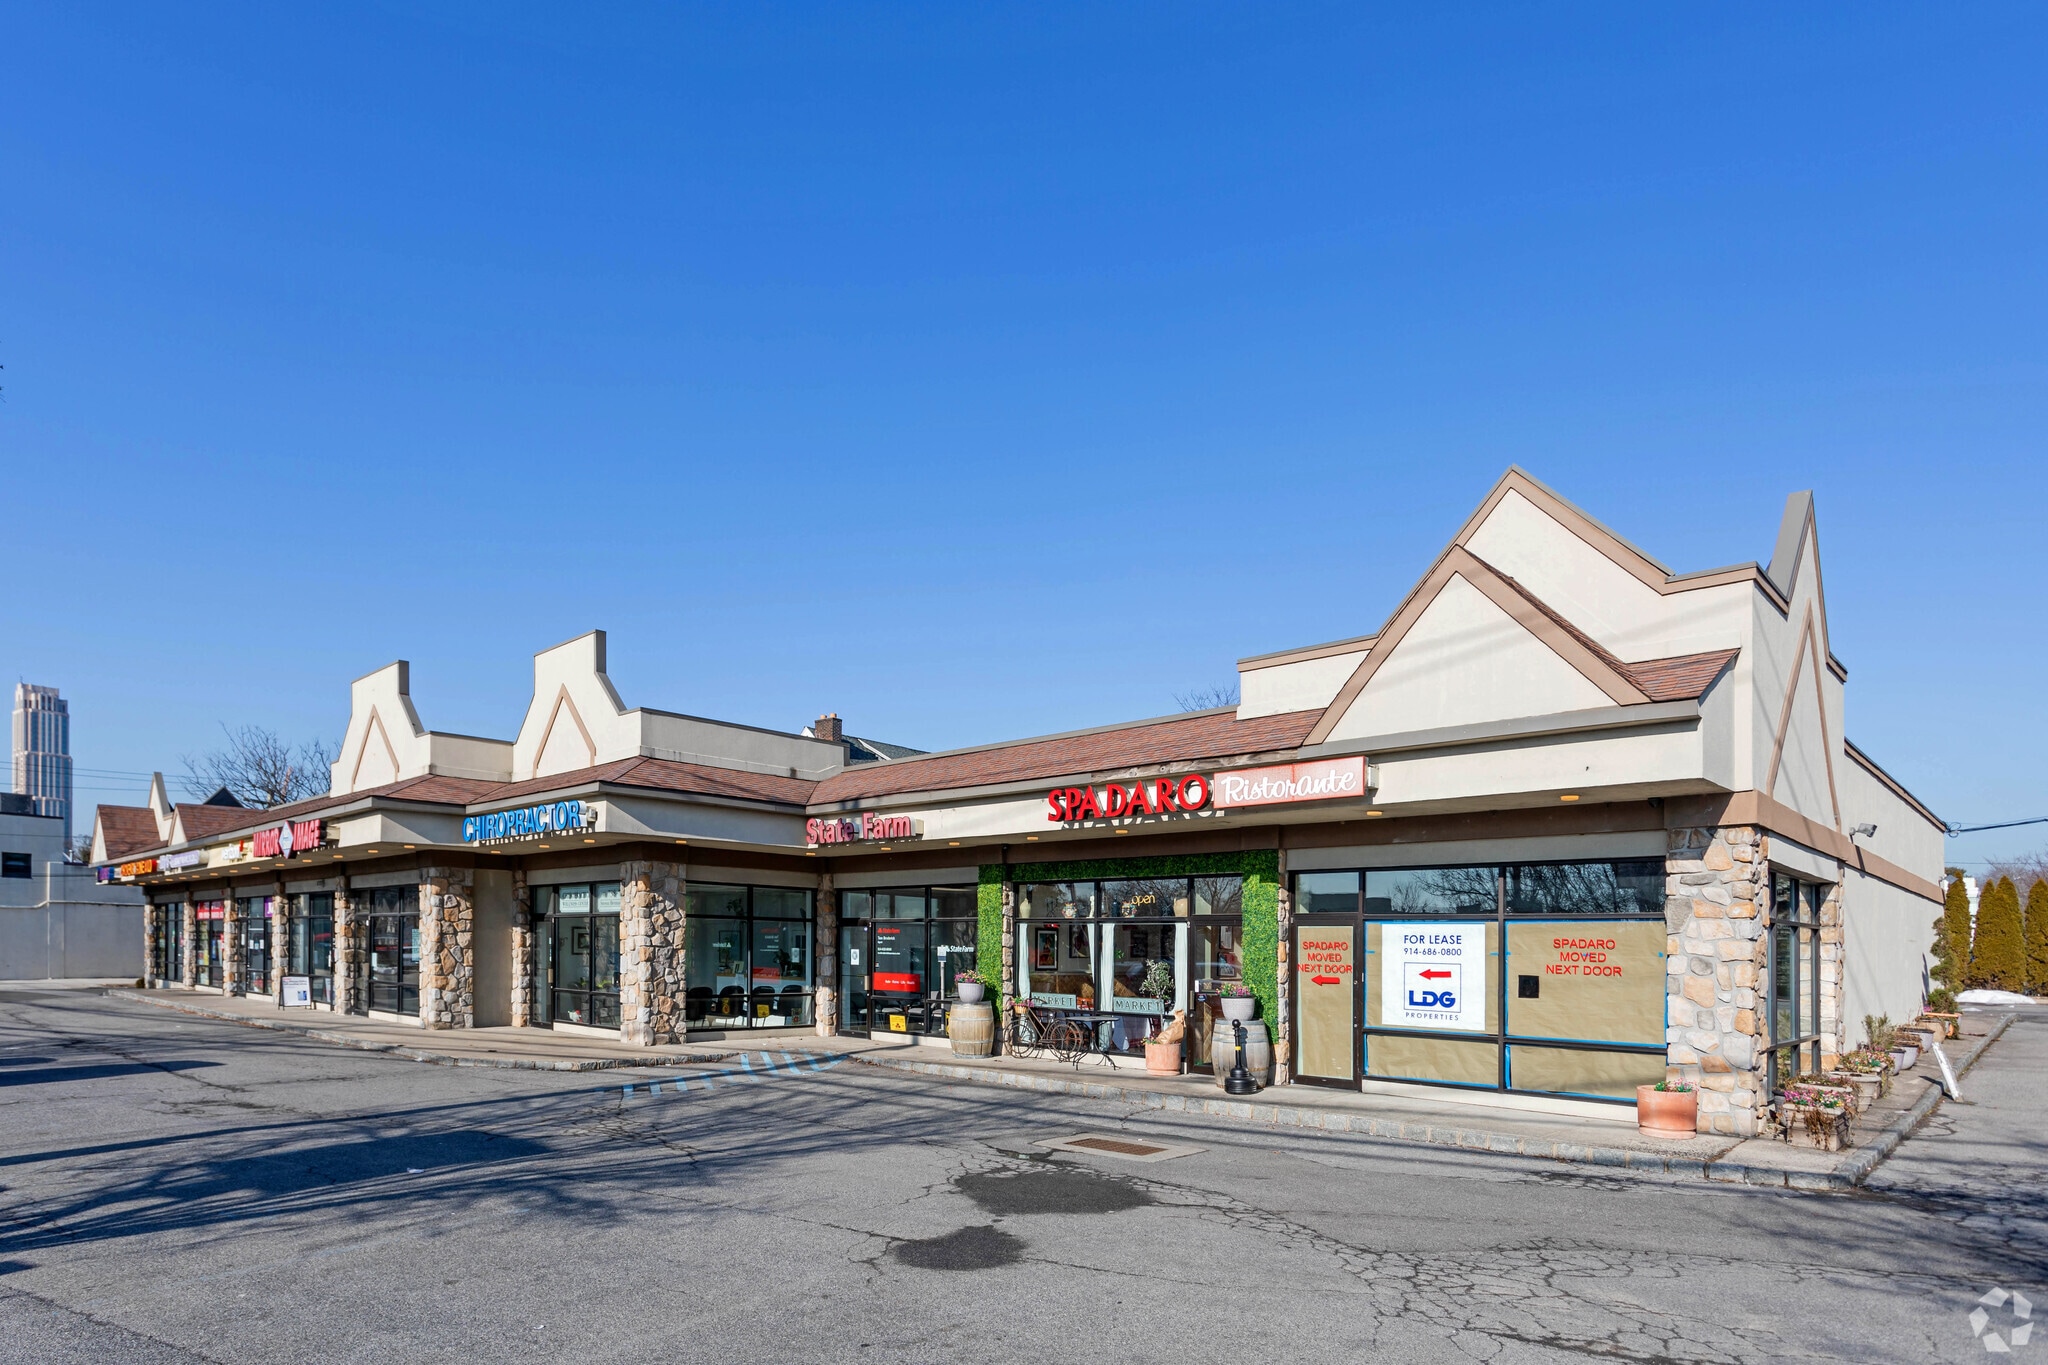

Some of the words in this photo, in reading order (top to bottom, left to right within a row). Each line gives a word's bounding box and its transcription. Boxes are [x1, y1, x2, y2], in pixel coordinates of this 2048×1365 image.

[1047, 773, 1209, 822] SPADARO
[1221, 769, 1357, 804] Ristorante
[462, 800, 582, 842] CHIROPRACTOR
[805, 817, 855, 845] State
[861, 811, 912, 840] Farm
[252, 827, 281, 858] MIRROR
[292, 818, 321, 851] IMAGE
[1130, 894, 1156, 907] open
[1403, 934, 1425, 945] FOR
[1429, 934, 1462, 945] LEASE
[1553, 938, 1616, 950] SPADARO
[1302, 941, 1349, 951] SPADARO
[1403, 947, 1462, 956] 914-686-0800
[1307, 952, 1342, 962] MOVED
[1560, 951, 1607, 963] MOVED
[1297, 963, 1322, 973] NEXT
[1324, 964, 1353, 974] DOOR
[1546, 964, 1579, 975] NEXT
[1583, 965, 1622, 977] DOOR
[1408, 990, 1456, 1008] LDG
[1115, 999, 1160, 1012] MARKET
[1405, 1012, 1459, 1021] PROPERTIES
